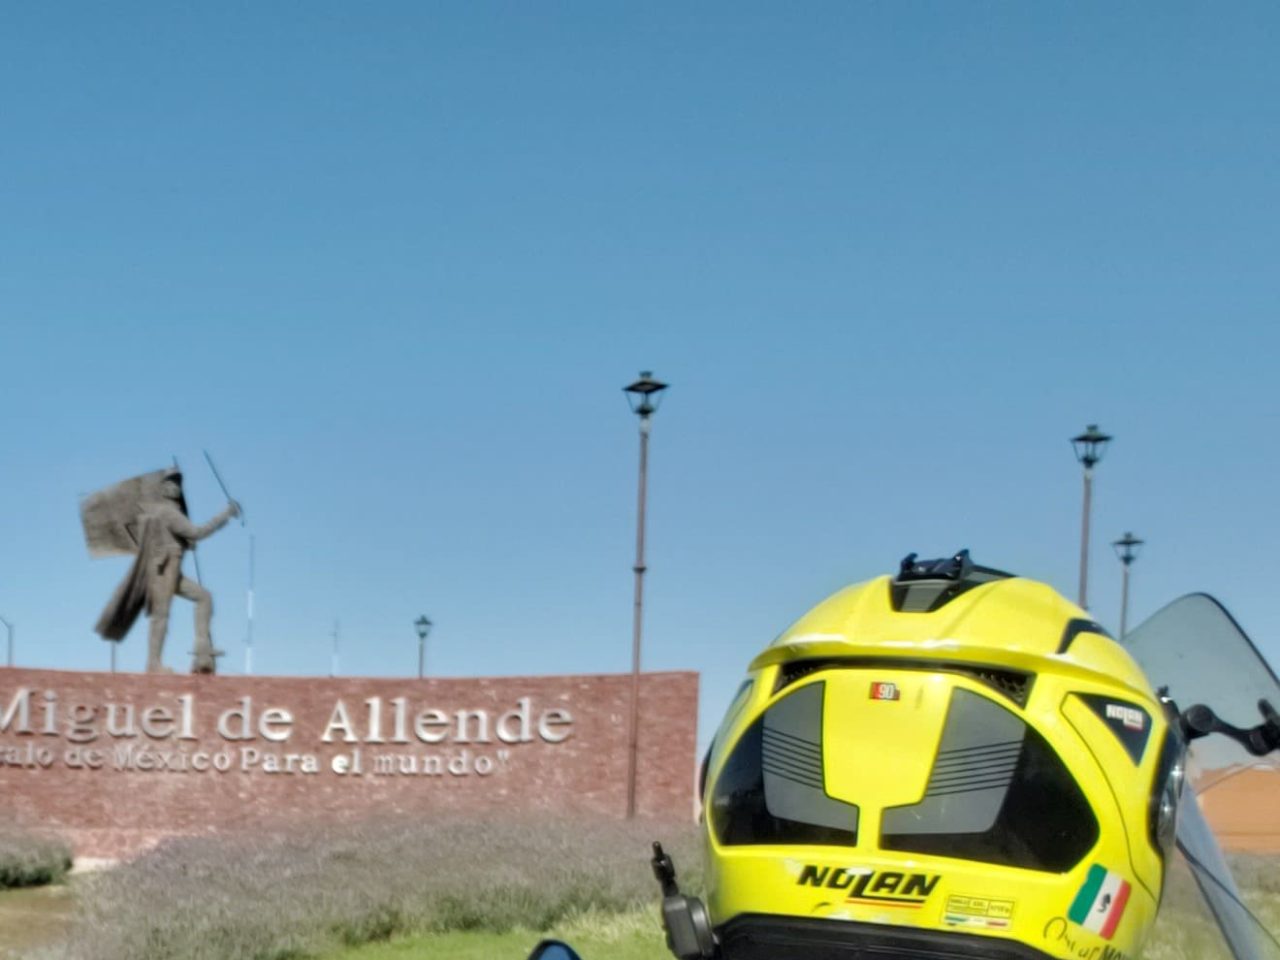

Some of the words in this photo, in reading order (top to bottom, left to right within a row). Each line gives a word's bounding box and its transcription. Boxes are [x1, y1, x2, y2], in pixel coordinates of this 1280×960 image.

[216, 696, 295, 741] de
[320, 696, 574, 744] Allende
[64, 743, 103, 769] de
[111, 741, 231, 773] México
[241, 748, 319, 774] Para
[331, 750, 363, 775] el
[373, 751, 510, 776] mundo"
[796, 865, 941, 904] NOLAN
